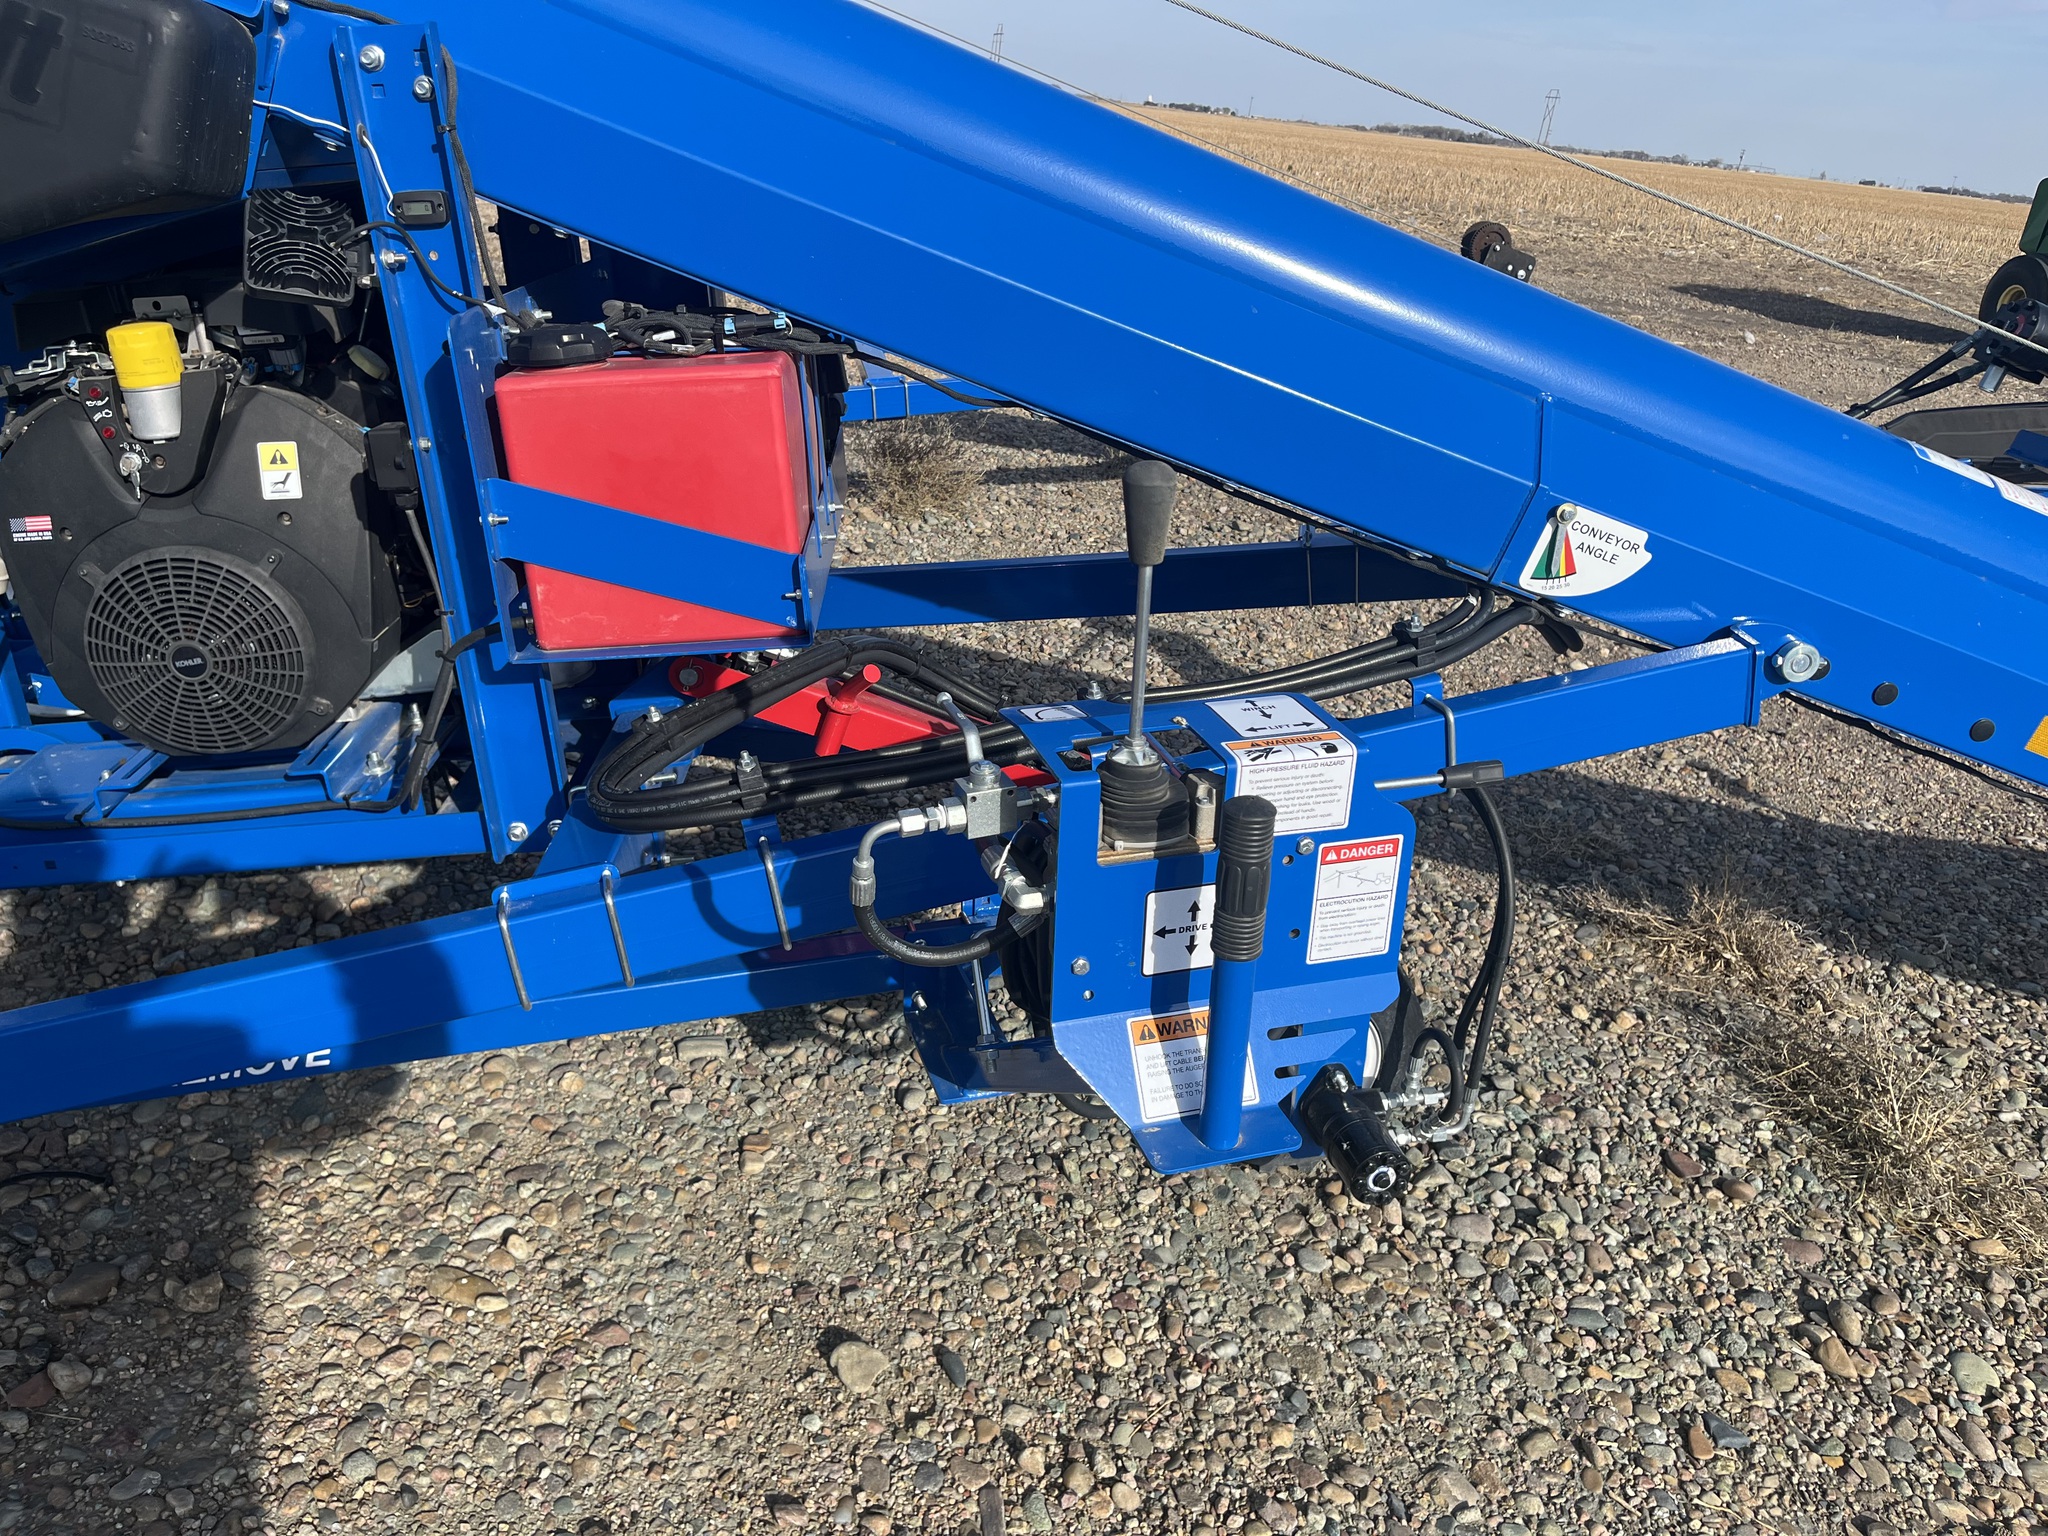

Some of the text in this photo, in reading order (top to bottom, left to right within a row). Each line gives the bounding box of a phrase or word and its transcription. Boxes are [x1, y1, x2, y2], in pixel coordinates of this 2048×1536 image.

[1571, 520, 1640, 555] CONVEYOR
[1575, 542, 1619, 565] ANGLE
[175, 657, 203, 668] KOHLER
[1263, 735, 1322, 746] WARNING
[1249, 764, 1299, 774] HIGH-PRESSURE
[1283, 788, 1304, 796] adjusting
[1340, 844, 1393, 859] DANGER
[1320, 894, 1388, 908] ELECTROCUTION HAZARD
[1179, 923, 1207, 934] DRIVE
[1156, 1016, 1209, 1037] WARN
[1145, 1053, 1171, 1063] UNHOOK
[1174, 1057, 1192, 1066] CABLE
[1147, 1069, 1172, 1078] RAISING
[1150, 1085, 1174, 1095] FAILURE
[1159, 1091, 1184, 1102] DAMAGE
